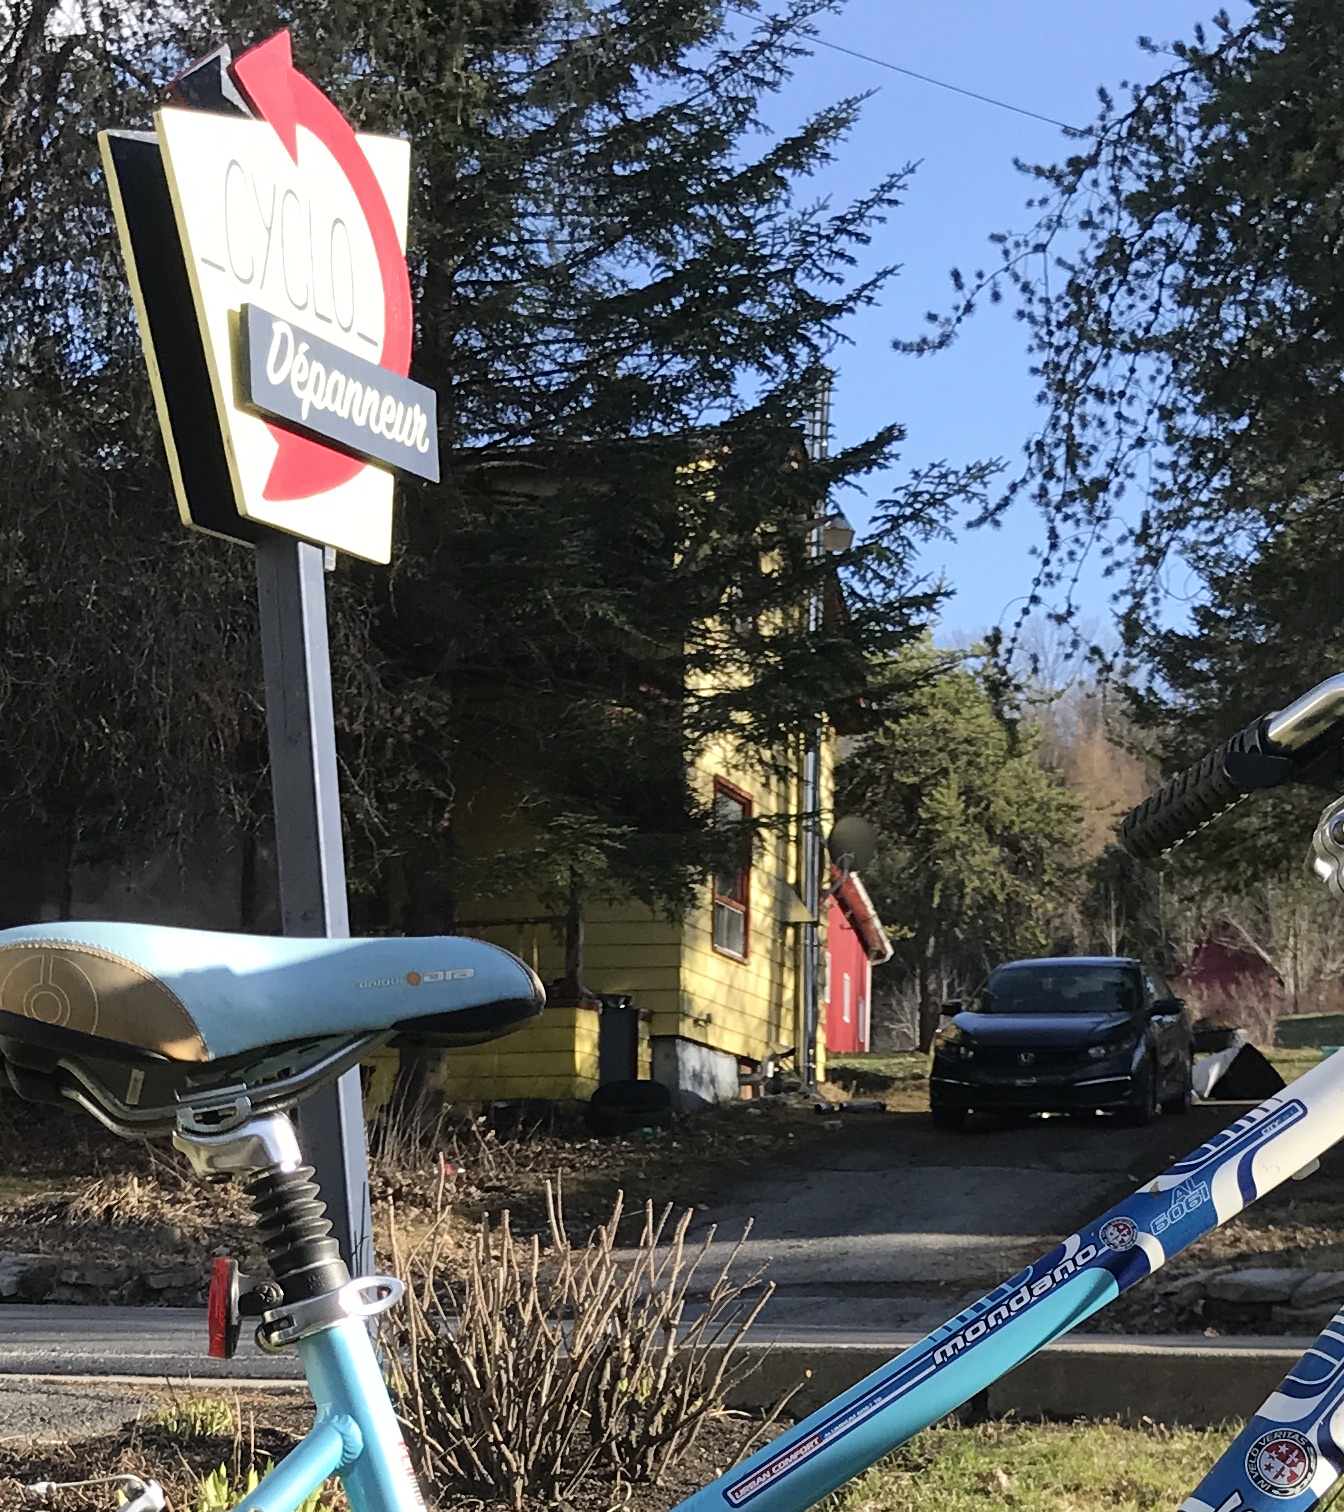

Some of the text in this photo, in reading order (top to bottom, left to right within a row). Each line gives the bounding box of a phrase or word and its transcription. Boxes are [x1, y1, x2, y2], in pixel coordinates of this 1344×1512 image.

[265, 321, 430, 453] Dépanneur
[1150, 1183, 1211, 1236] 6061
[1171, 1177, 1206, 1208] AL
[932, 1244, 1097, 1366] mondano
[1258, 1431, 1309, 1447] VERITAS
[734, 1470, 771, 1500] URBAN
[771, 1436, 821, 1476] COMFORT
[1248, 1447, 1260, 1479] VELO
[1257, 1479, 1272, 1491] IN
